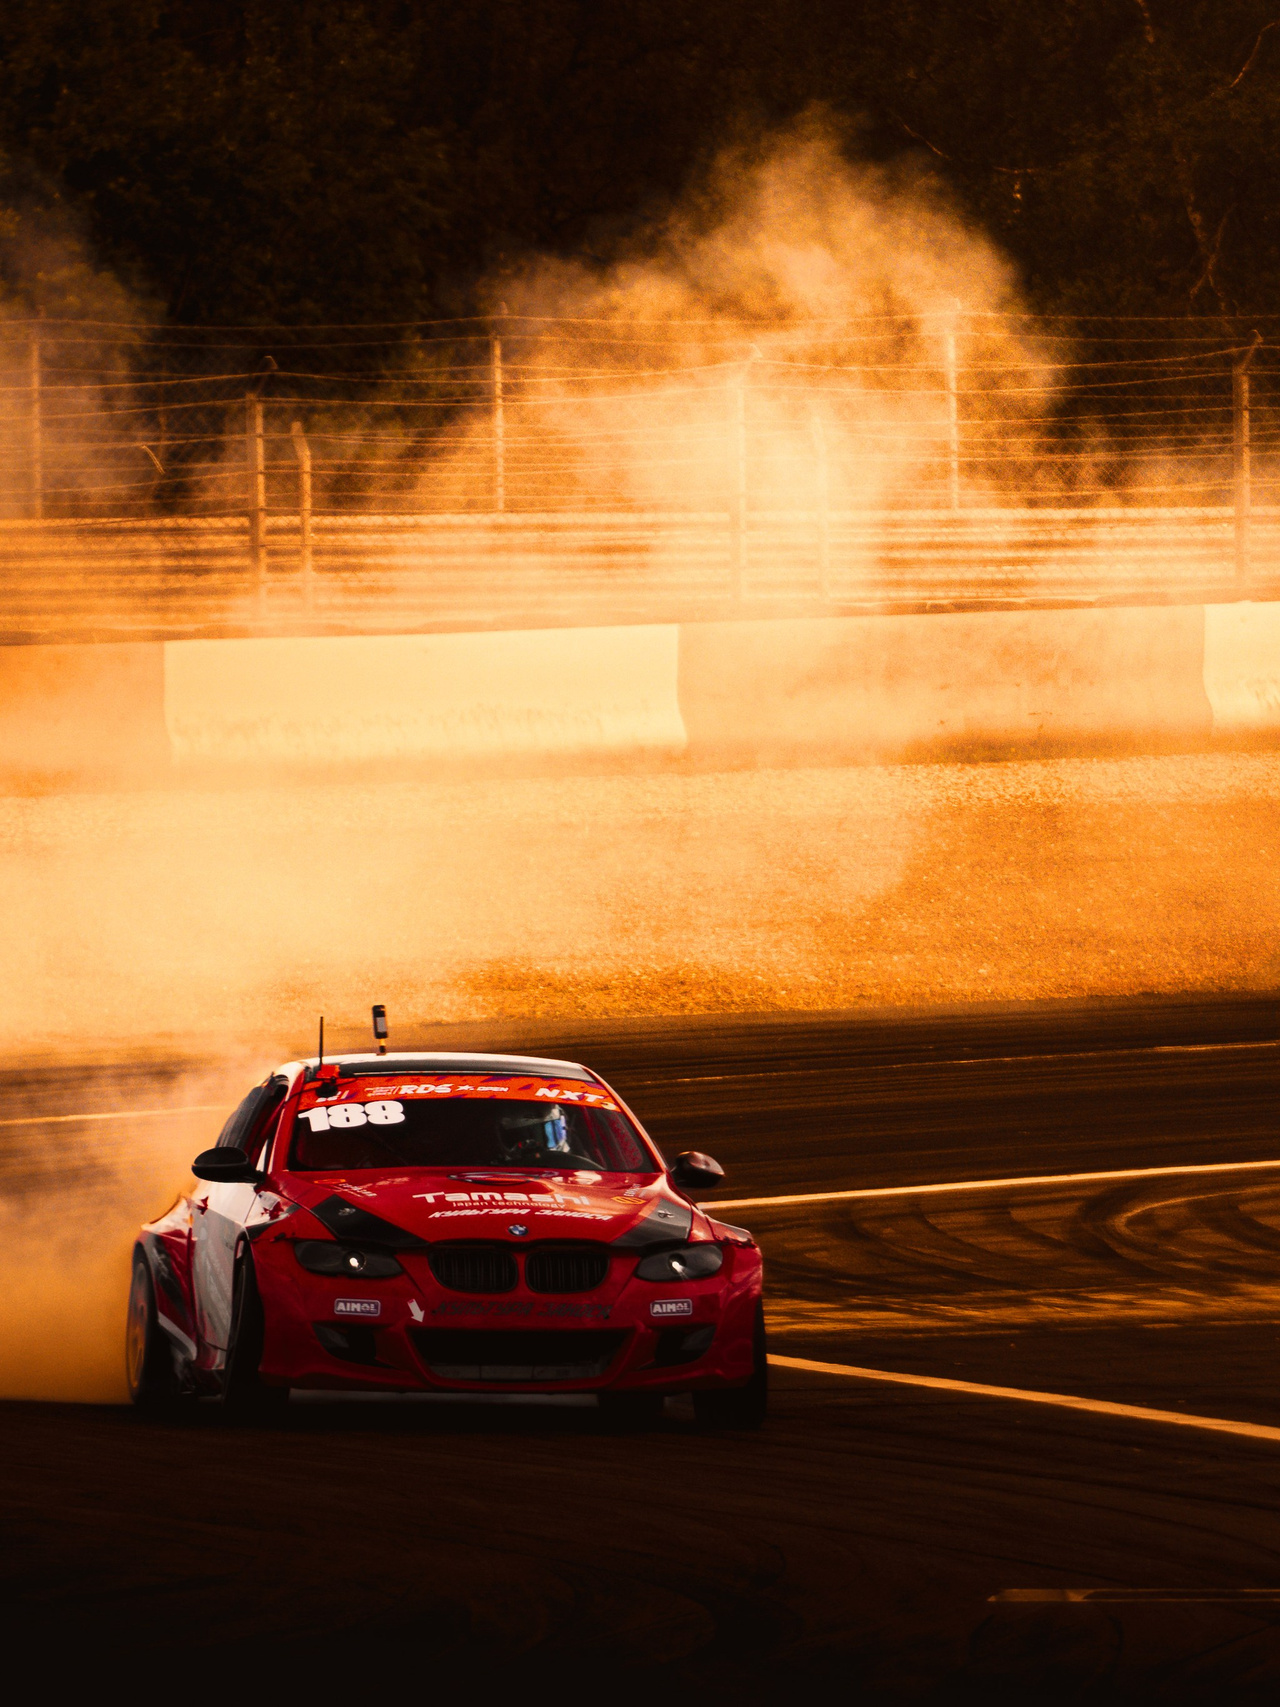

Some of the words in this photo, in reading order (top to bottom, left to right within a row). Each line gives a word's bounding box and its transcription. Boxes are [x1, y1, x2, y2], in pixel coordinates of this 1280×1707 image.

[398, 1083, 454, 1095] RDS
[535, 1087, 605, 1103] NXT
[298, 1100, 406, 1133] 188
[412, 1191, 591, 1206] Tamashi
[492, 1200, 566, 1209] technology
[336, 1302, 377, 1312] AIMOL
[652, 1302, 690, 1313] AIMOL
